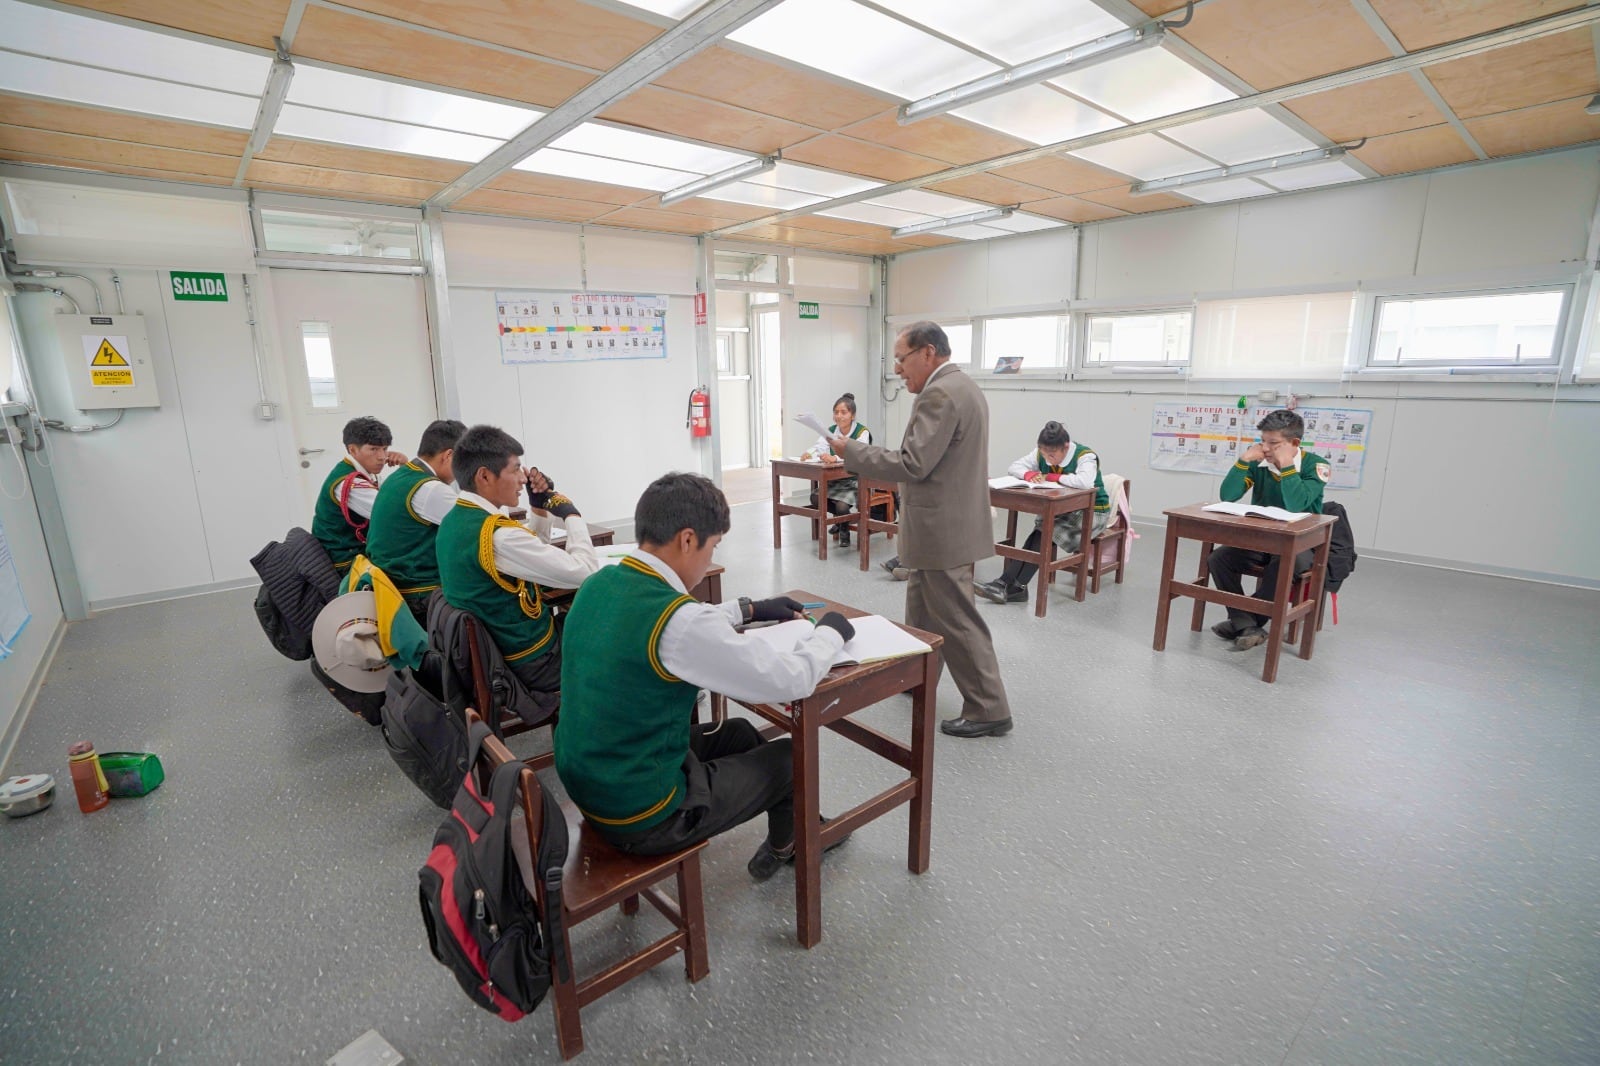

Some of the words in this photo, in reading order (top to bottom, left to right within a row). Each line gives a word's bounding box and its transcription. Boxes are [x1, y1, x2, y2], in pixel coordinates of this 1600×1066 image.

[173, 277, 226, 296] SALIDA
[799, 304, 818, 316] SALIDA
[1186, 406, 1223, 414] HISTORIA
